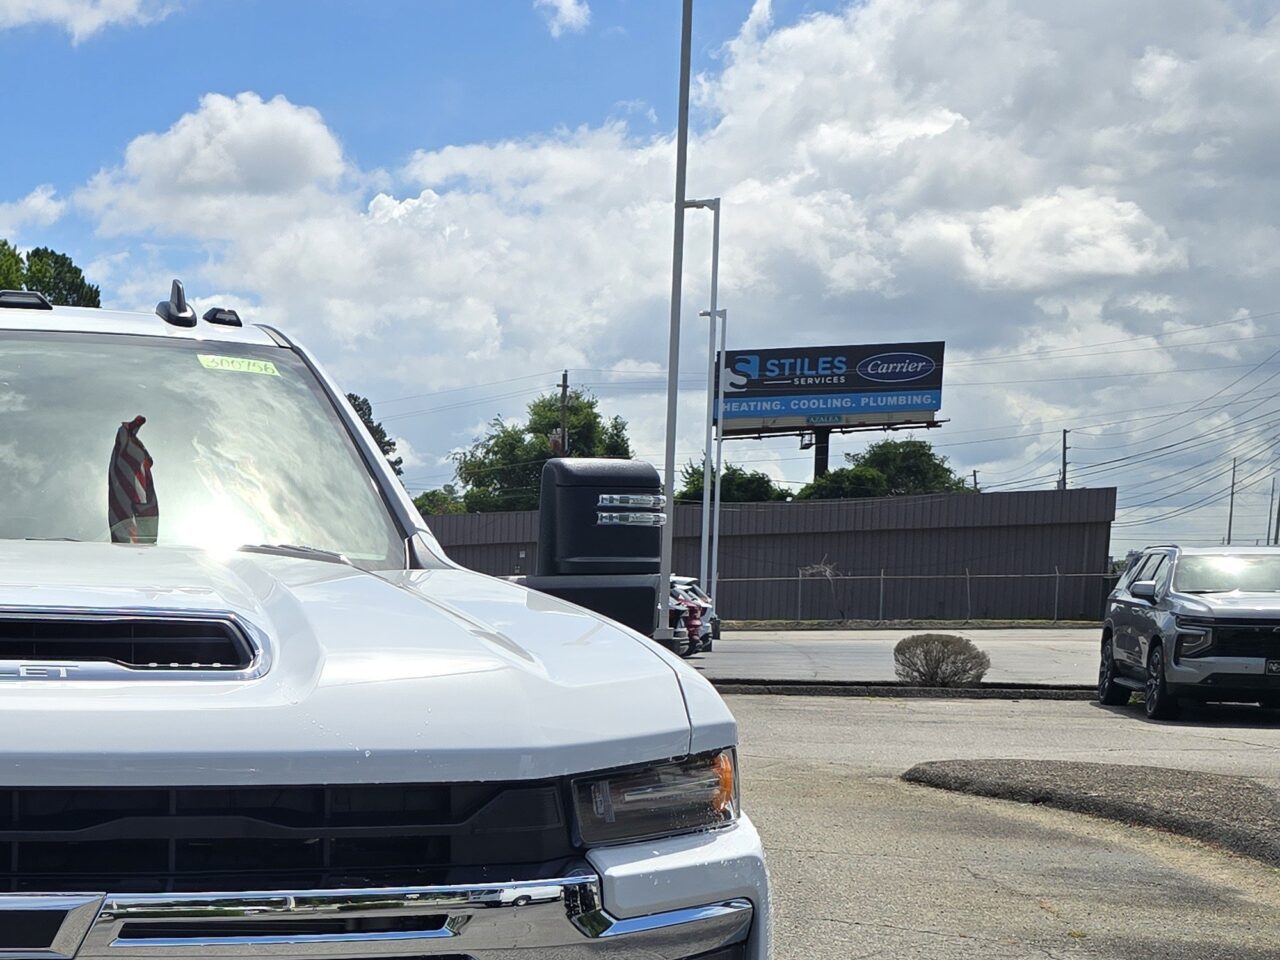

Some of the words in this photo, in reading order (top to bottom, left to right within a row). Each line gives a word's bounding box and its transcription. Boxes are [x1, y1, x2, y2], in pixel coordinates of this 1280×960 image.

[766, 356, 847, 376] STILES
[867, 359, 926, 375] Carrier
[793, 375, 846, 385] SERVICES
[791, 398, 856, 409] COOLING.
[861, 394, 936, 406] PLUMBING.
[809, 416, 840, 424] AZALEA
